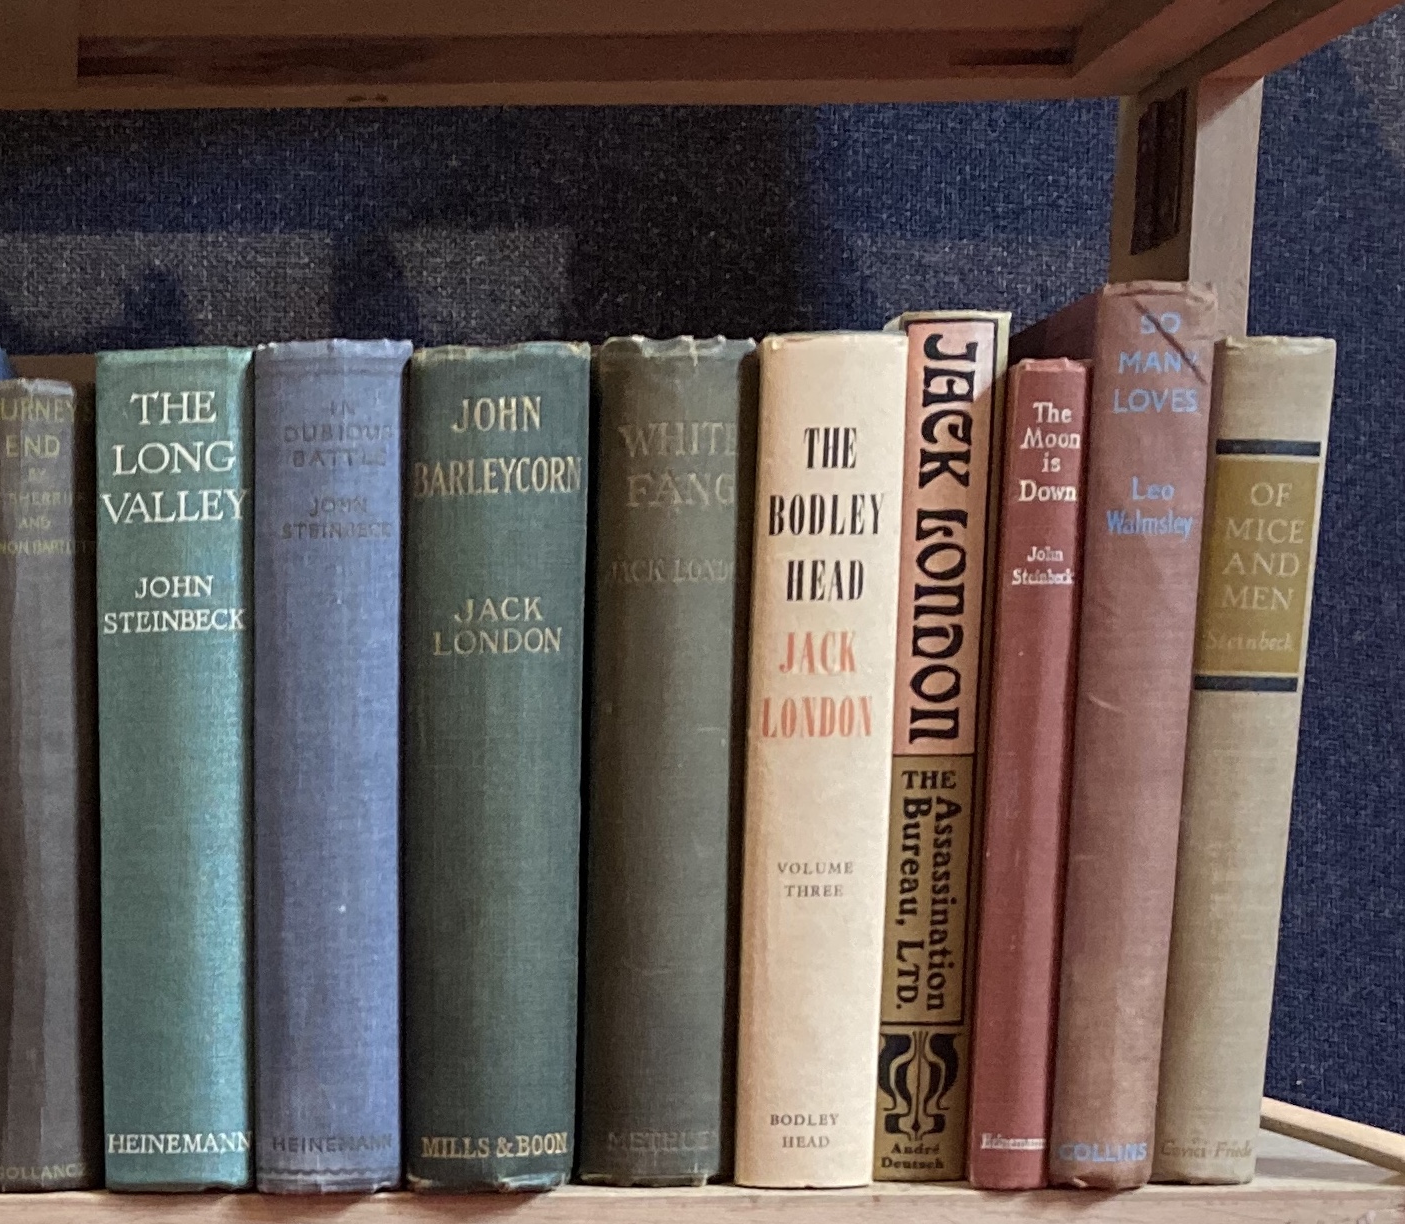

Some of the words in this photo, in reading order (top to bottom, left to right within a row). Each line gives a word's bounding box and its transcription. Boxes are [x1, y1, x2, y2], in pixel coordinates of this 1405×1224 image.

[129, 389, 217, 426] THE
[450, 395, 543, 433] JOHN
[1033, 401, 1073, 426] The
[1112, 389, 1200, 416] LOVES
[803, 426, 858, 470] THE
[1020, 429, 1082, 451] Moon
[111, 440, 237, 477] LONG
[1041, 452, 1062, 474] is
[1019, 480, 1078, 503] Down
[1131, 476, 1175, 502] Leo
[1251, 482, 1294, 509] OF
[99, 488, 249, 525] VALLEY
[768, 493, 886, 537] BODLEY
[1106, 509, 1194, 540] Walmsley
[1224, 518, 1306, 546] MICE
[134, 574, 215, 600] JOHN
[785, 559, 866, 602] HEAD
[103, 608, 246, 635] STEINBECK
[454, 596, 544, 625] JACK
[433, 626, 564, 657] LONDON
[779, 631, 858, 674] JACK
[761, 695, 873, 738] LONDON
[901, 769, 957, 791] THE
[777, 861, 855, 877] VOLUME
[784, 884, 845, 899] THREE
[925, 796, 963, 1012] Assassination
[769, 1112, 839, 1127] BODLEY
[106, 1131, 252, 1155] HEINEMANN
[421, 1135, 491, 1160] MILLS
[517, 1132, 568, 1156] BOON
[781, 1135, 831, 1150] HEAD
